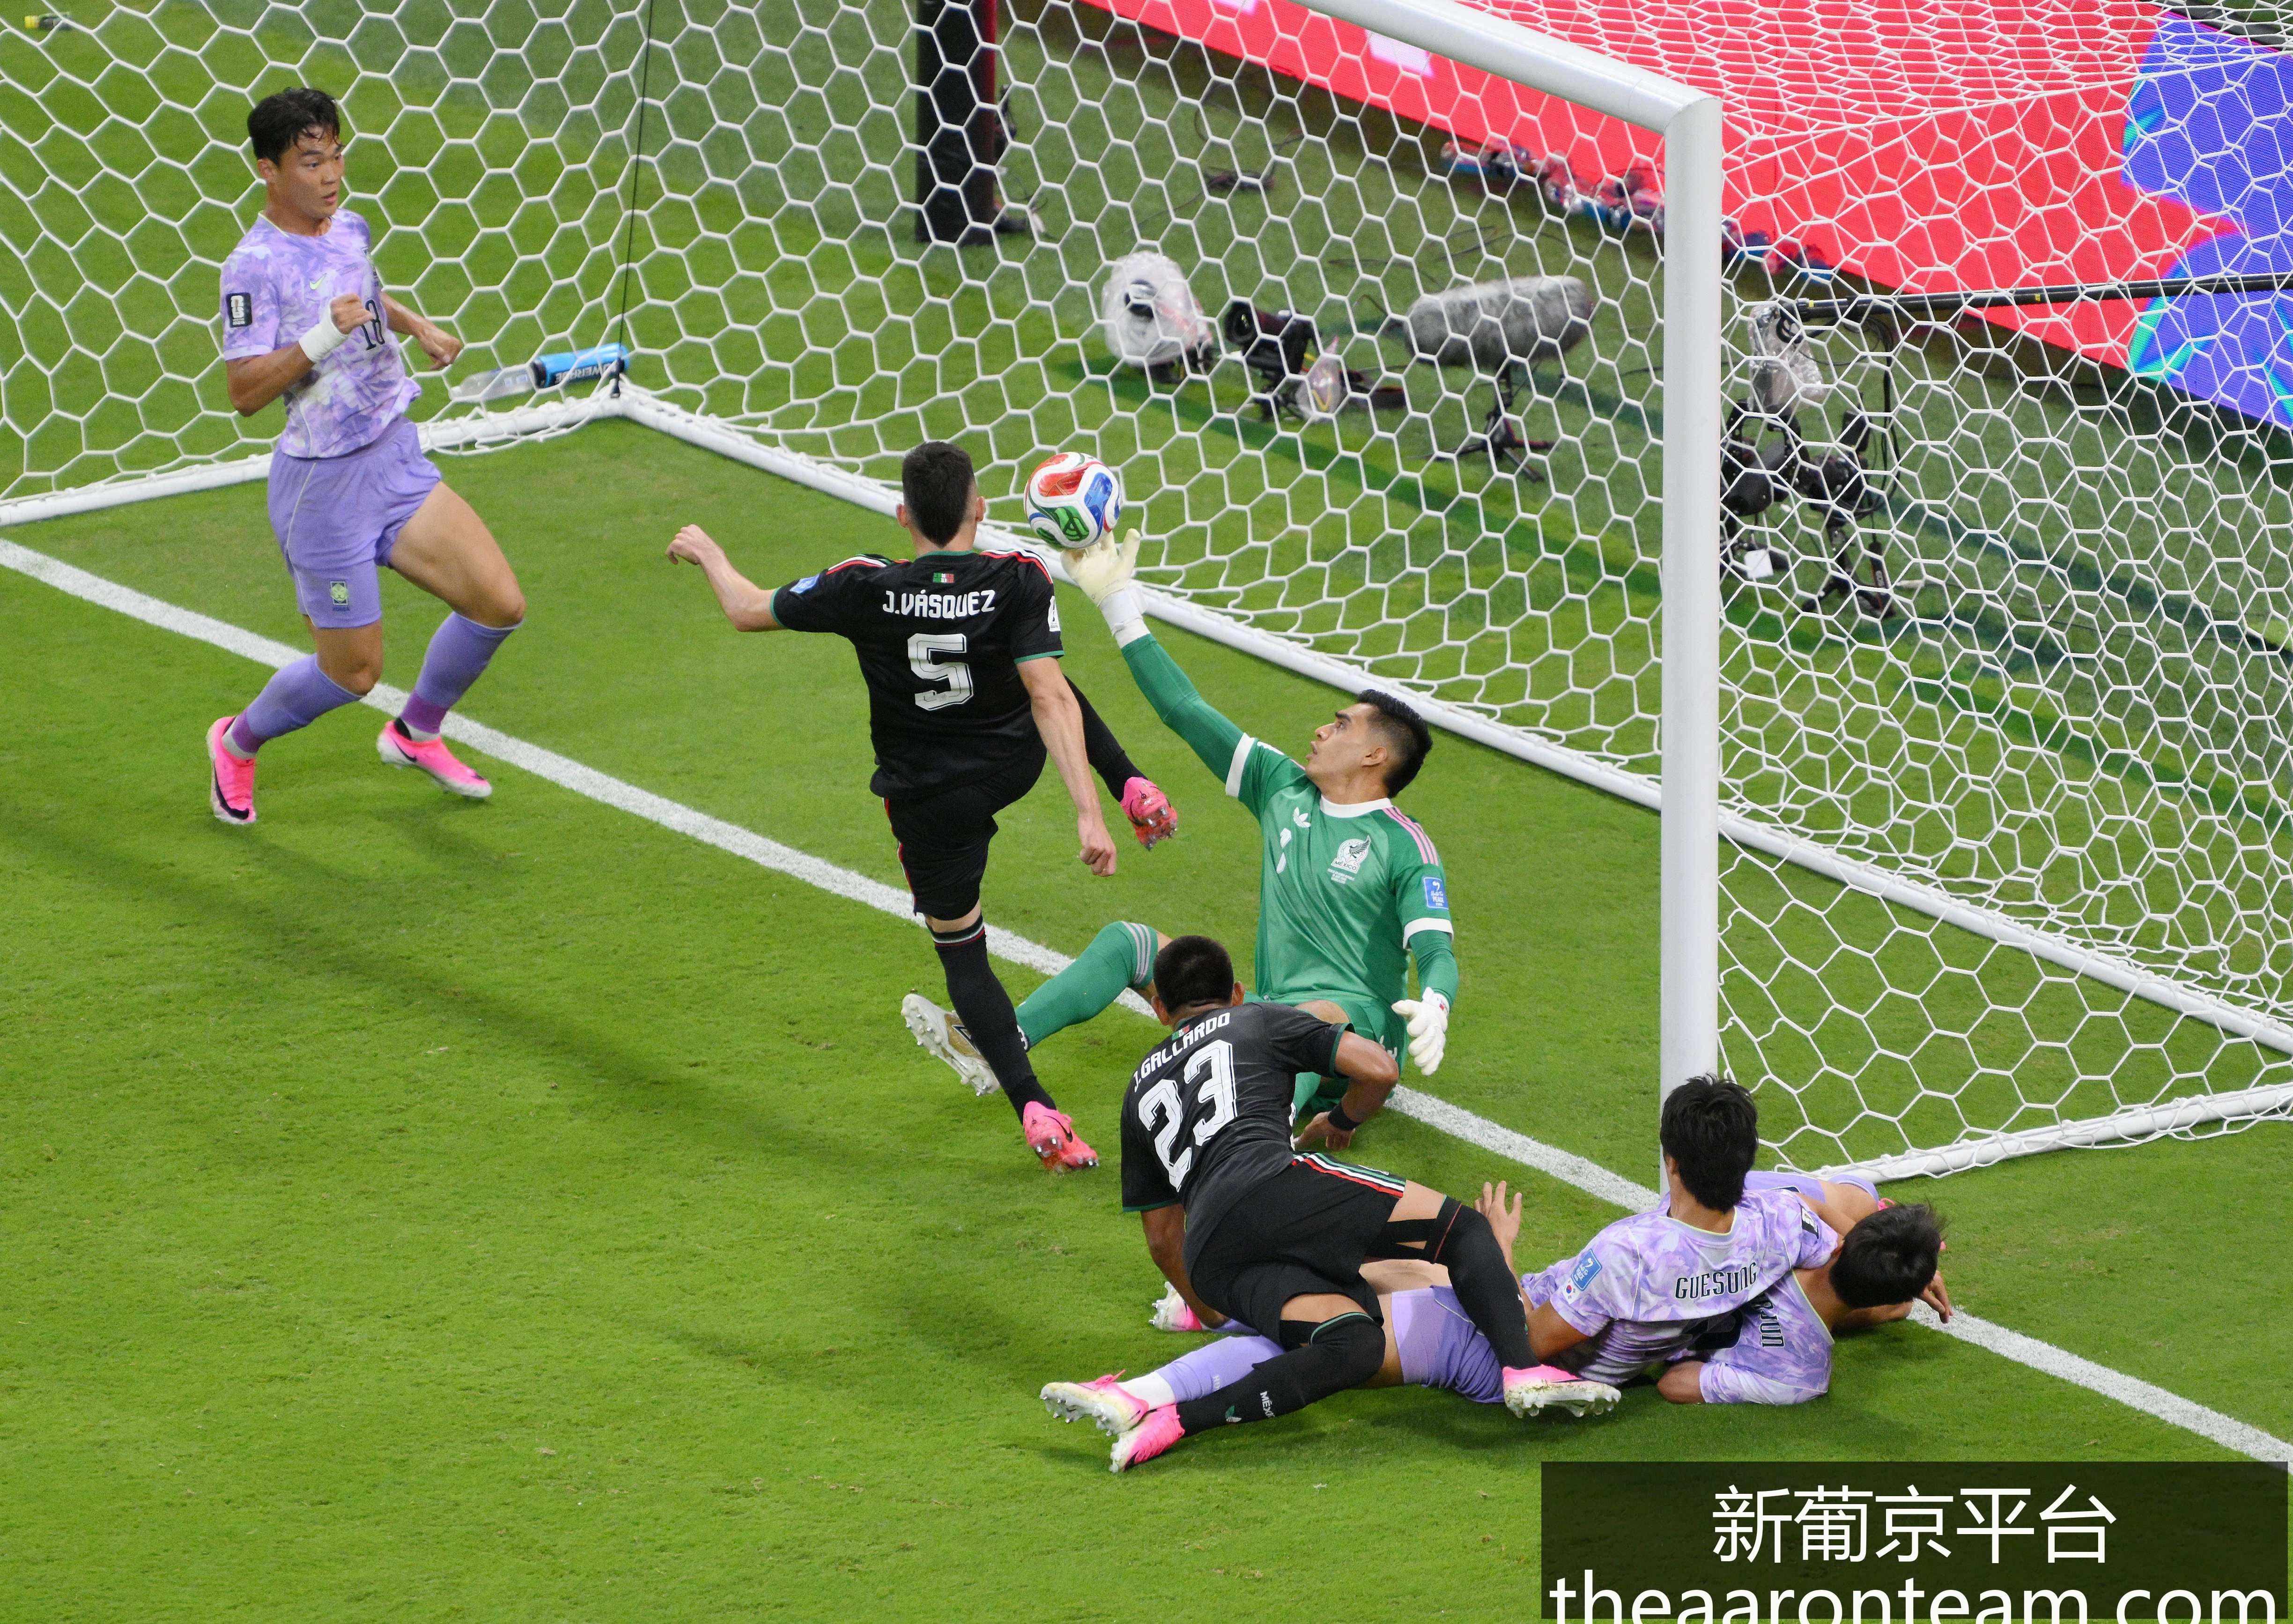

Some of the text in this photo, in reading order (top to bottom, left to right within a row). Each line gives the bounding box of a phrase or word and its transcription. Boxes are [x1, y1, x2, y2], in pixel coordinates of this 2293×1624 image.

[882, 589, 995, 619] J.VÁSQUEZ
[908, 633, 974, 711] 5
[1133, 1012, 1230, 1093] J.GALLARDO
[1138, 1039, 1238, 1192] 23
[1675, 1262, 1756, 1299] GUESUNG
